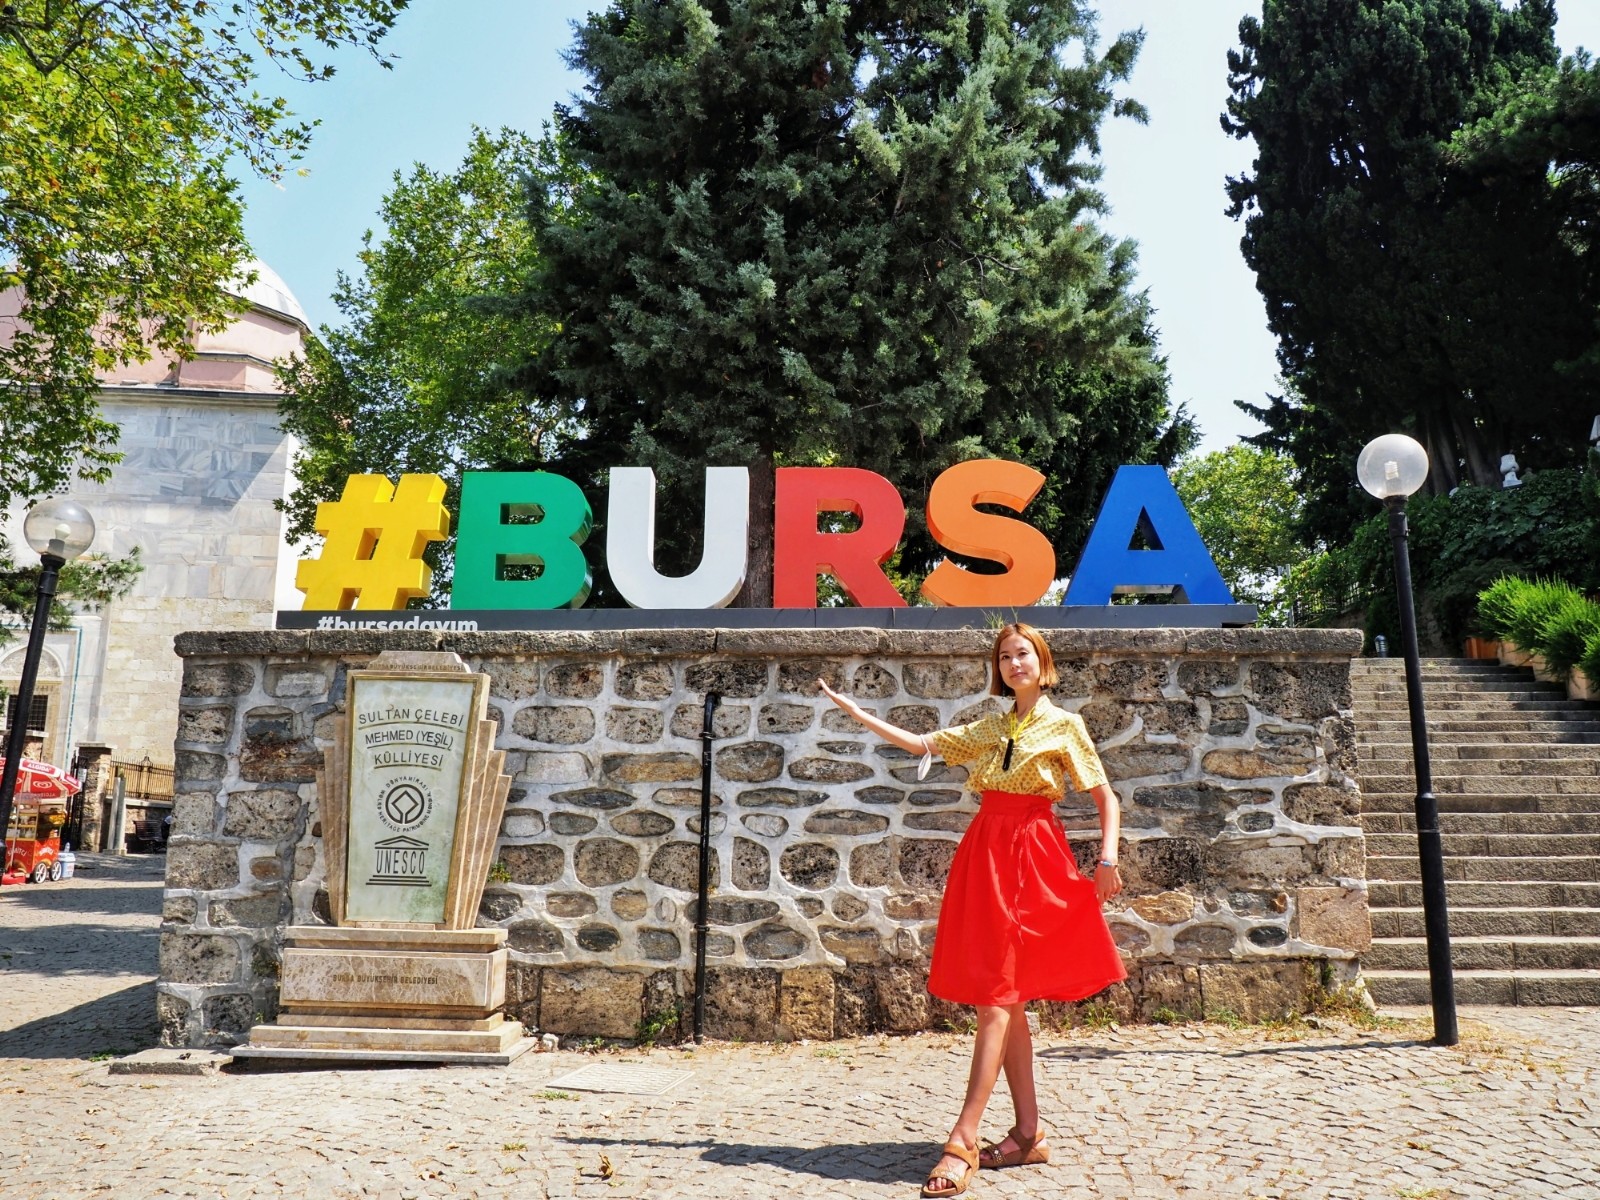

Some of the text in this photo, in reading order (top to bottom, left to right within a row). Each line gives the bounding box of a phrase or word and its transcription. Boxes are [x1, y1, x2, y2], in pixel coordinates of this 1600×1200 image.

[296, 459, 1235, 611] #BURSA
[359, 708, 464, 726] SULTAN ÇELEBİ
[365, 730, 454, 751] MEHMED (YEŞİL)
[376, 850, 425, 874] UNESCO
